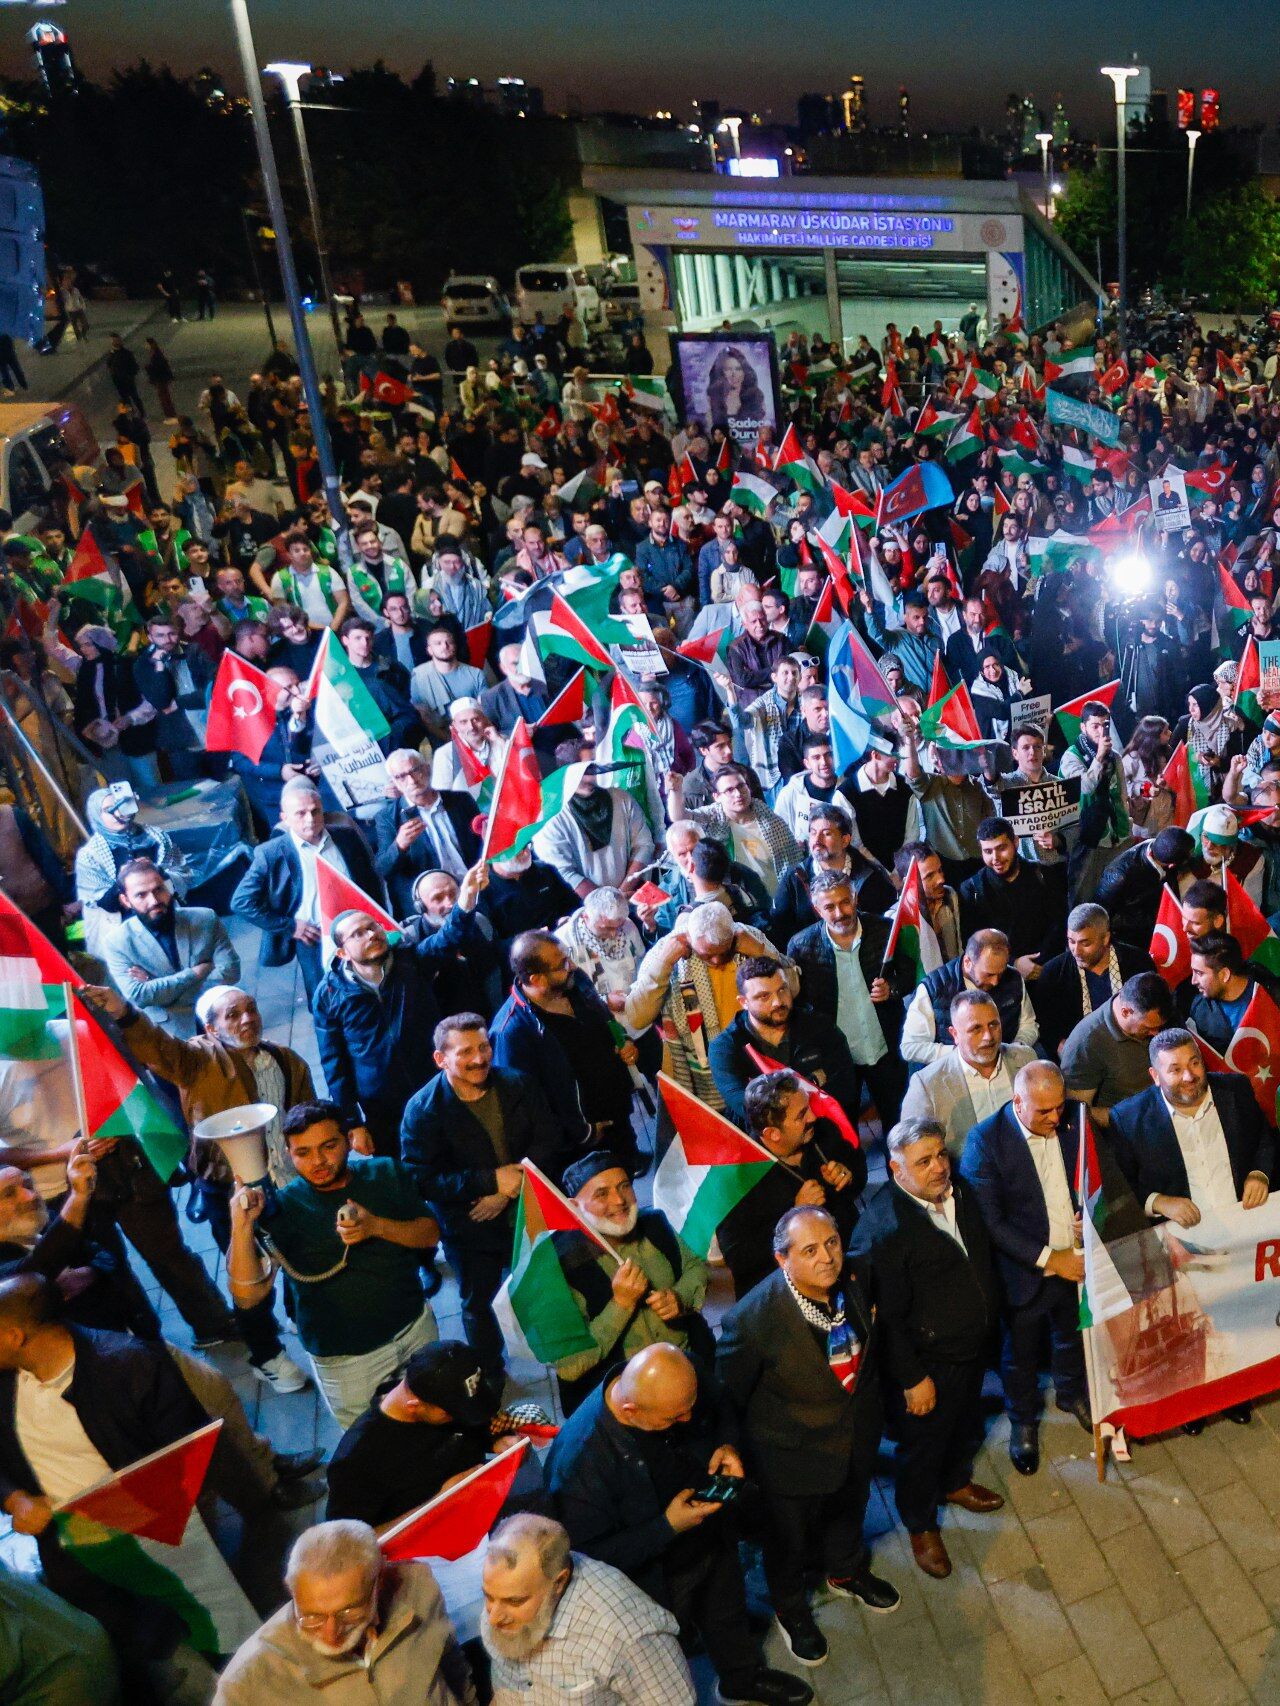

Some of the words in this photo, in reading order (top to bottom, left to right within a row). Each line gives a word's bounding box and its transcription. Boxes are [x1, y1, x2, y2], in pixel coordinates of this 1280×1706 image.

[715, 213, 797, 228] MARMARAY
[800, 211, 870, 230] ÜSKÜDAR
[873, 213, 952, 232] İSTASYONU
[1262, 656, 1279, 668] THE
[1021, 702, 1041, 711] Free
[1019, 783, 1067, 802] KATİL
